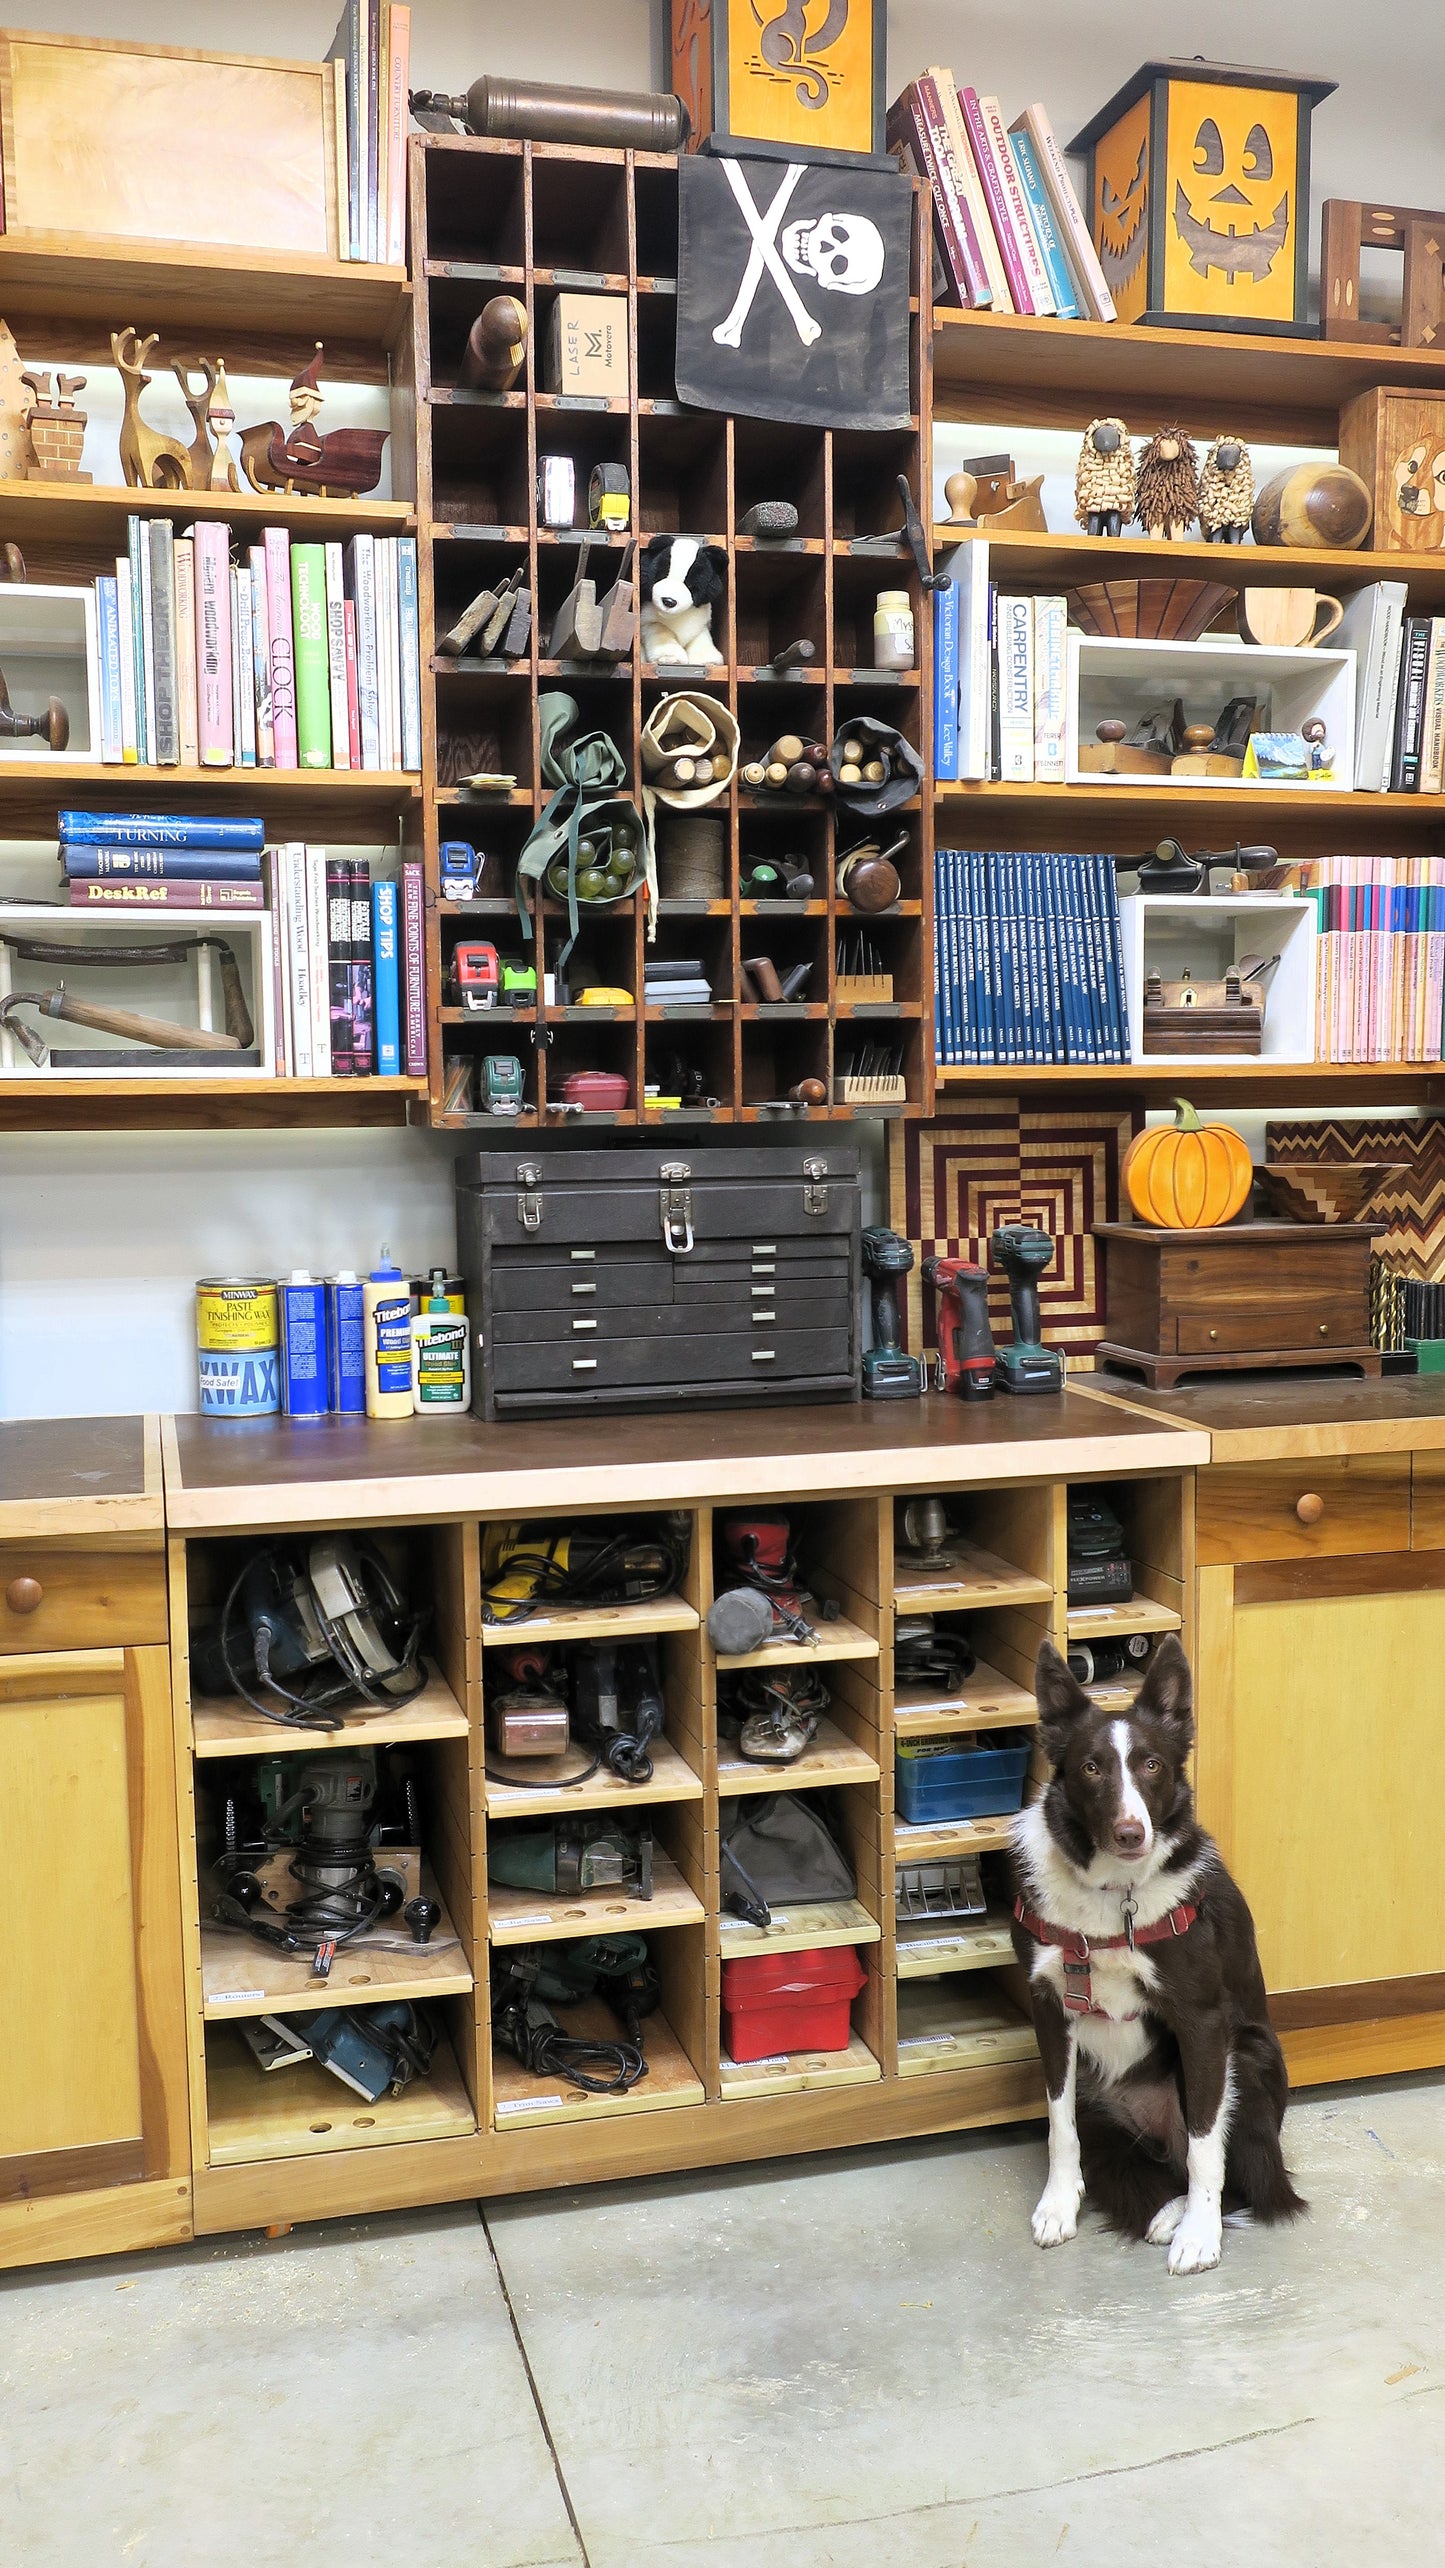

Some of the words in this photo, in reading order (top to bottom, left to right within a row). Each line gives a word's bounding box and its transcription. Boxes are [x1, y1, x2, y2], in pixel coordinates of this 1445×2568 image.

[970, 99, 978, 109] IN
[973, 112, 983, 130] THE
[978, 131, 991, 155] ARTS
[914, 114, 930, 154] MEASURE
[932, 184, 942, 202] CUT
[937, 202, 950, 228] ONCE
[988, 163, 1001, 195] CRAFTS
[1046, 136, 1061, 175] WEEKEND
[1058, 173, 1073, 210] PROJECTS
[1069, 207, 1079, 224] PLUS
[991, 115, 1016, 185] OUTDOOR
[1010, 186, 1041, 277] STRUCTURES
[996, 196, 1008, 222] STYLE
[567, 320, 579, 376] LASER
[362, 548, 371, 565] The
[177, 553, 191, 618] WOODWORKING
[203, 556, 216, 594] Modern
[239, 593, 249, 616] Drill
[298, 562, 310, 639] TECHNOLOGY
[362, 570, 373, 639] Woodworker's
[155, 586, 170, 682] THEORY
[240, 618, 250, 646] Press
[310, 602, 321, 640] WOOD
[330, 601, 343, 637] SHOP
[944, 601, 954, 639] Victorian
[107, 605, 118, 669] ANIMATED
[204, 600, 220, 675] woodworking
[242, 648, 251, 674] Book
[331, 638, 345, 681] SAVVY
[365, 644, 374, 686] Problem
[942, 641, 953, 673] Design
[1012, 604, 1028, 712] CARPENTRY
[1411, 641, 1426, 681] VISUAL
[110, 672, 119, 702] TOYS
[272, 637, 293, 721] CLOCK
[944, 674, 953, 698] Book
[158, 687, 172, 754] SHOP
[366, 690, 376, 720] Solver
[943, 724, 953, 742] Lee
[941, 742, 953, 766] Valley
[1432, 733, 1440, 769] HANDBOOK
[116, 828, 187, 842] TURNING
[87, 885, 168, 901] DeskRef
[292, 852, 304, 923] Understanding
[378, 887, 393, 925] SHOP
[408, 901, 418, 920] FINE
[273, 937, 279, 945] OF
[296, 925, 306, 953] Wood
[380, 929, 394, 959] TIPS
[408, 922, 419, 951] POINTS
[1104, 923, 1112, 962] SHARPENING
[409, 952, 419, 964] OF
[297, 968, 307, 1007] Hoadley
[409, 966, 421, 1012] FURNITURE
[223, 1291, 256, 1299] MINWAX
[227, 1302, 252, 1311] PASTE
[208, 1312, 252, 1320] FINISHING
[254, 1310, 270, 1318] WAX
[419, 1327, 464, 1347] Titebond
[423, 1352, 458, 1360] ULTIMATE
